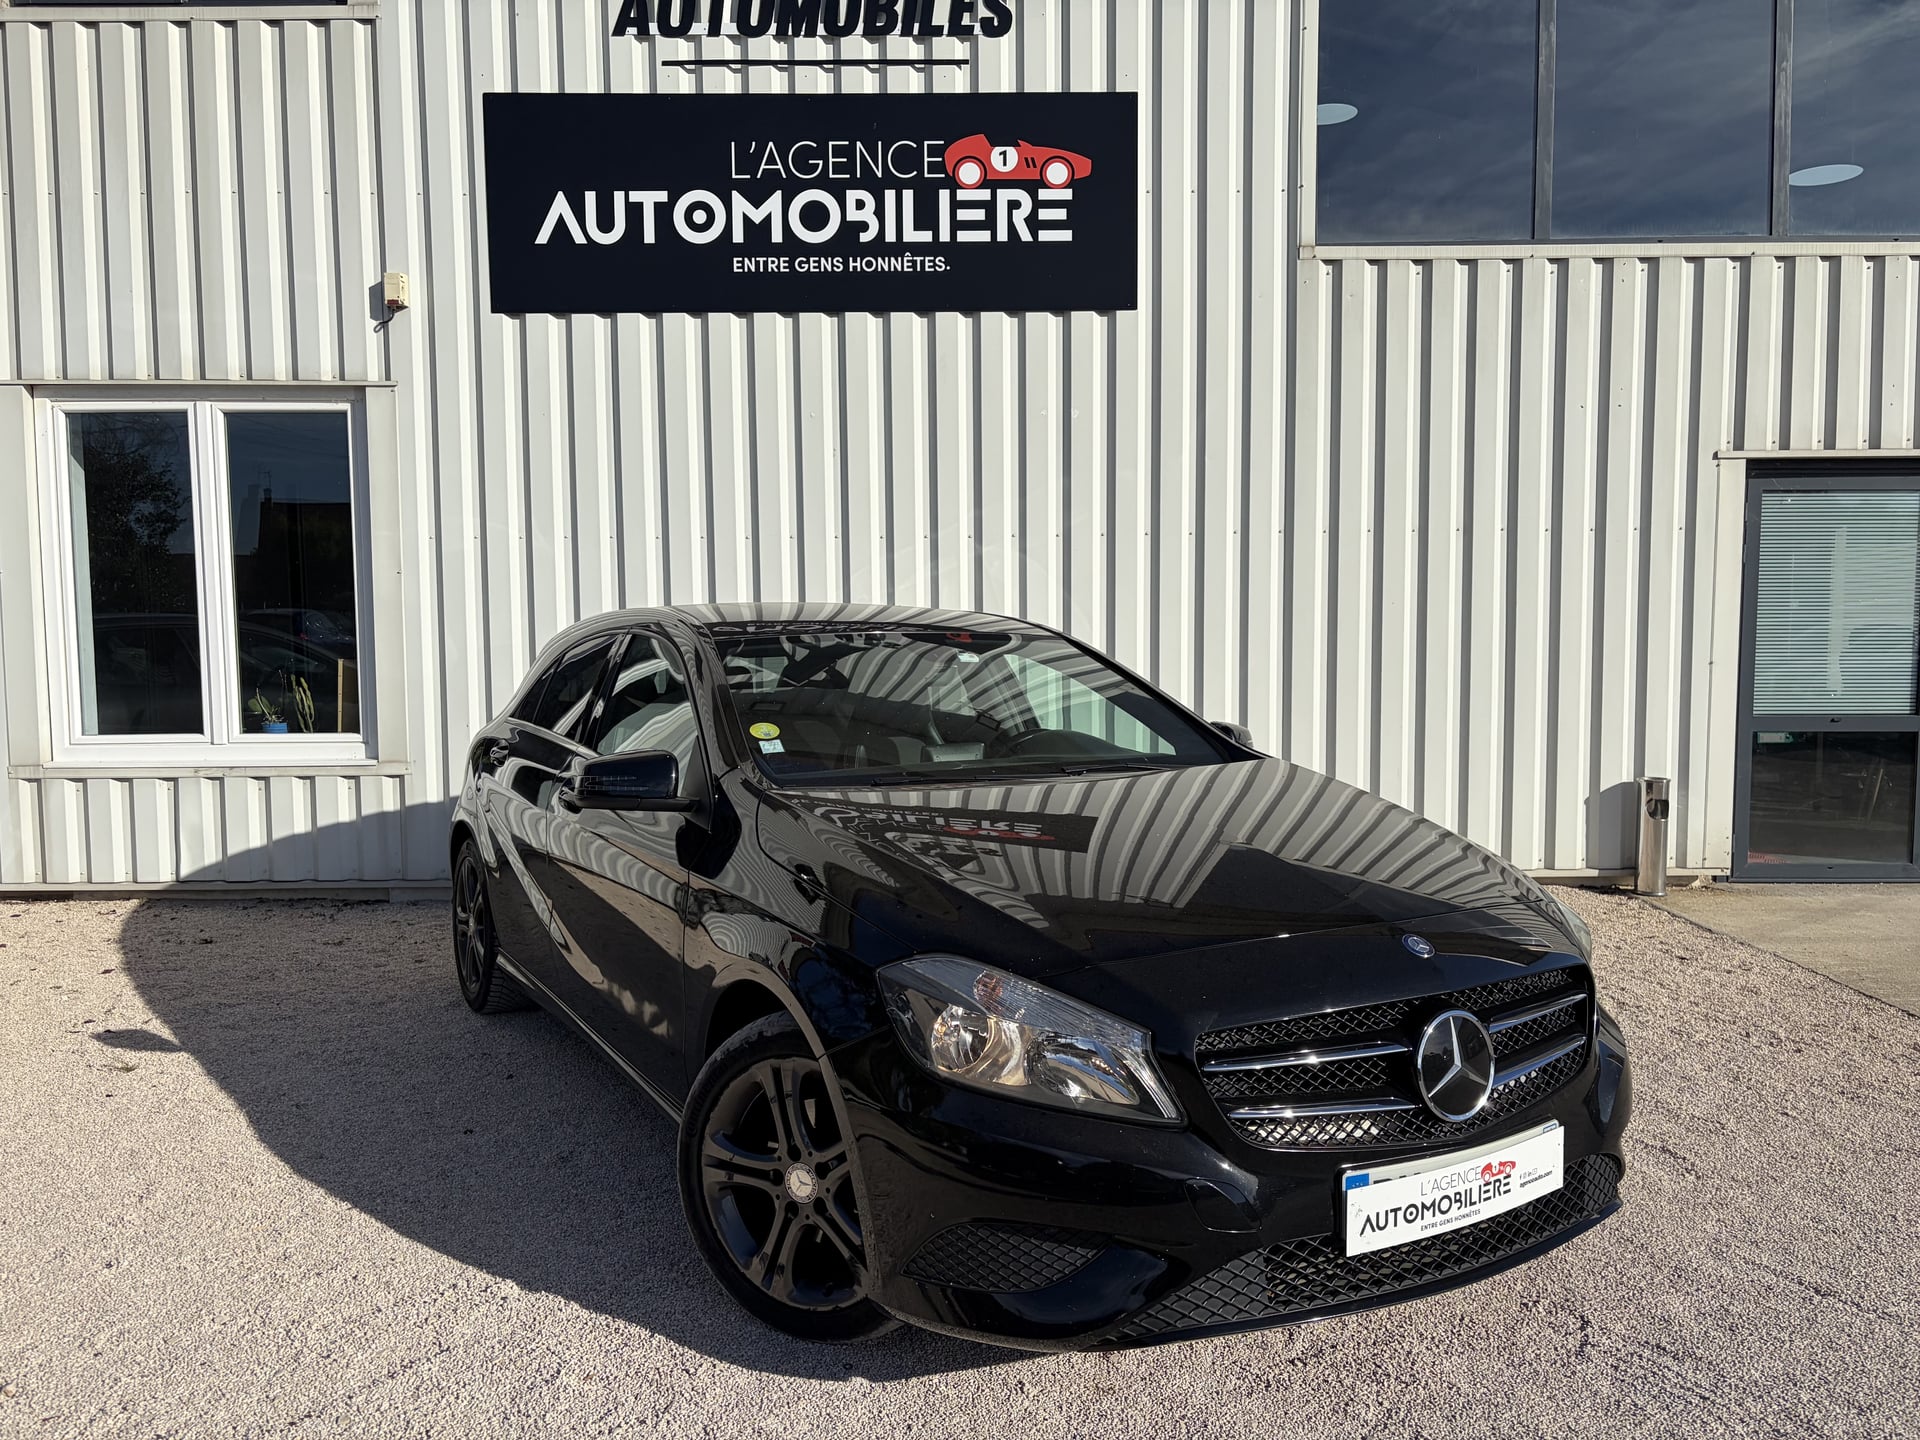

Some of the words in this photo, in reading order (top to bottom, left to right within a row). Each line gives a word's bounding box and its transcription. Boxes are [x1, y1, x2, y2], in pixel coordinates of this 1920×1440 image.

[612, 0, 1013, 38] AUTOMOBILES
[731, 140, 945, 179] L'AGENCE
[998, 149, 1009, 167] 1
[733, 257, 790, 273] ENTRE
[794, 256, 844, 273] GENS
[848, 252, 951, 273] HONNÊTES.
[1420, 1165, 1481, 1196] L'AGENCE
[1420, 1221, 1438, 1231] ENTRE
[1438, 1217, 1454, 1226] GENS
